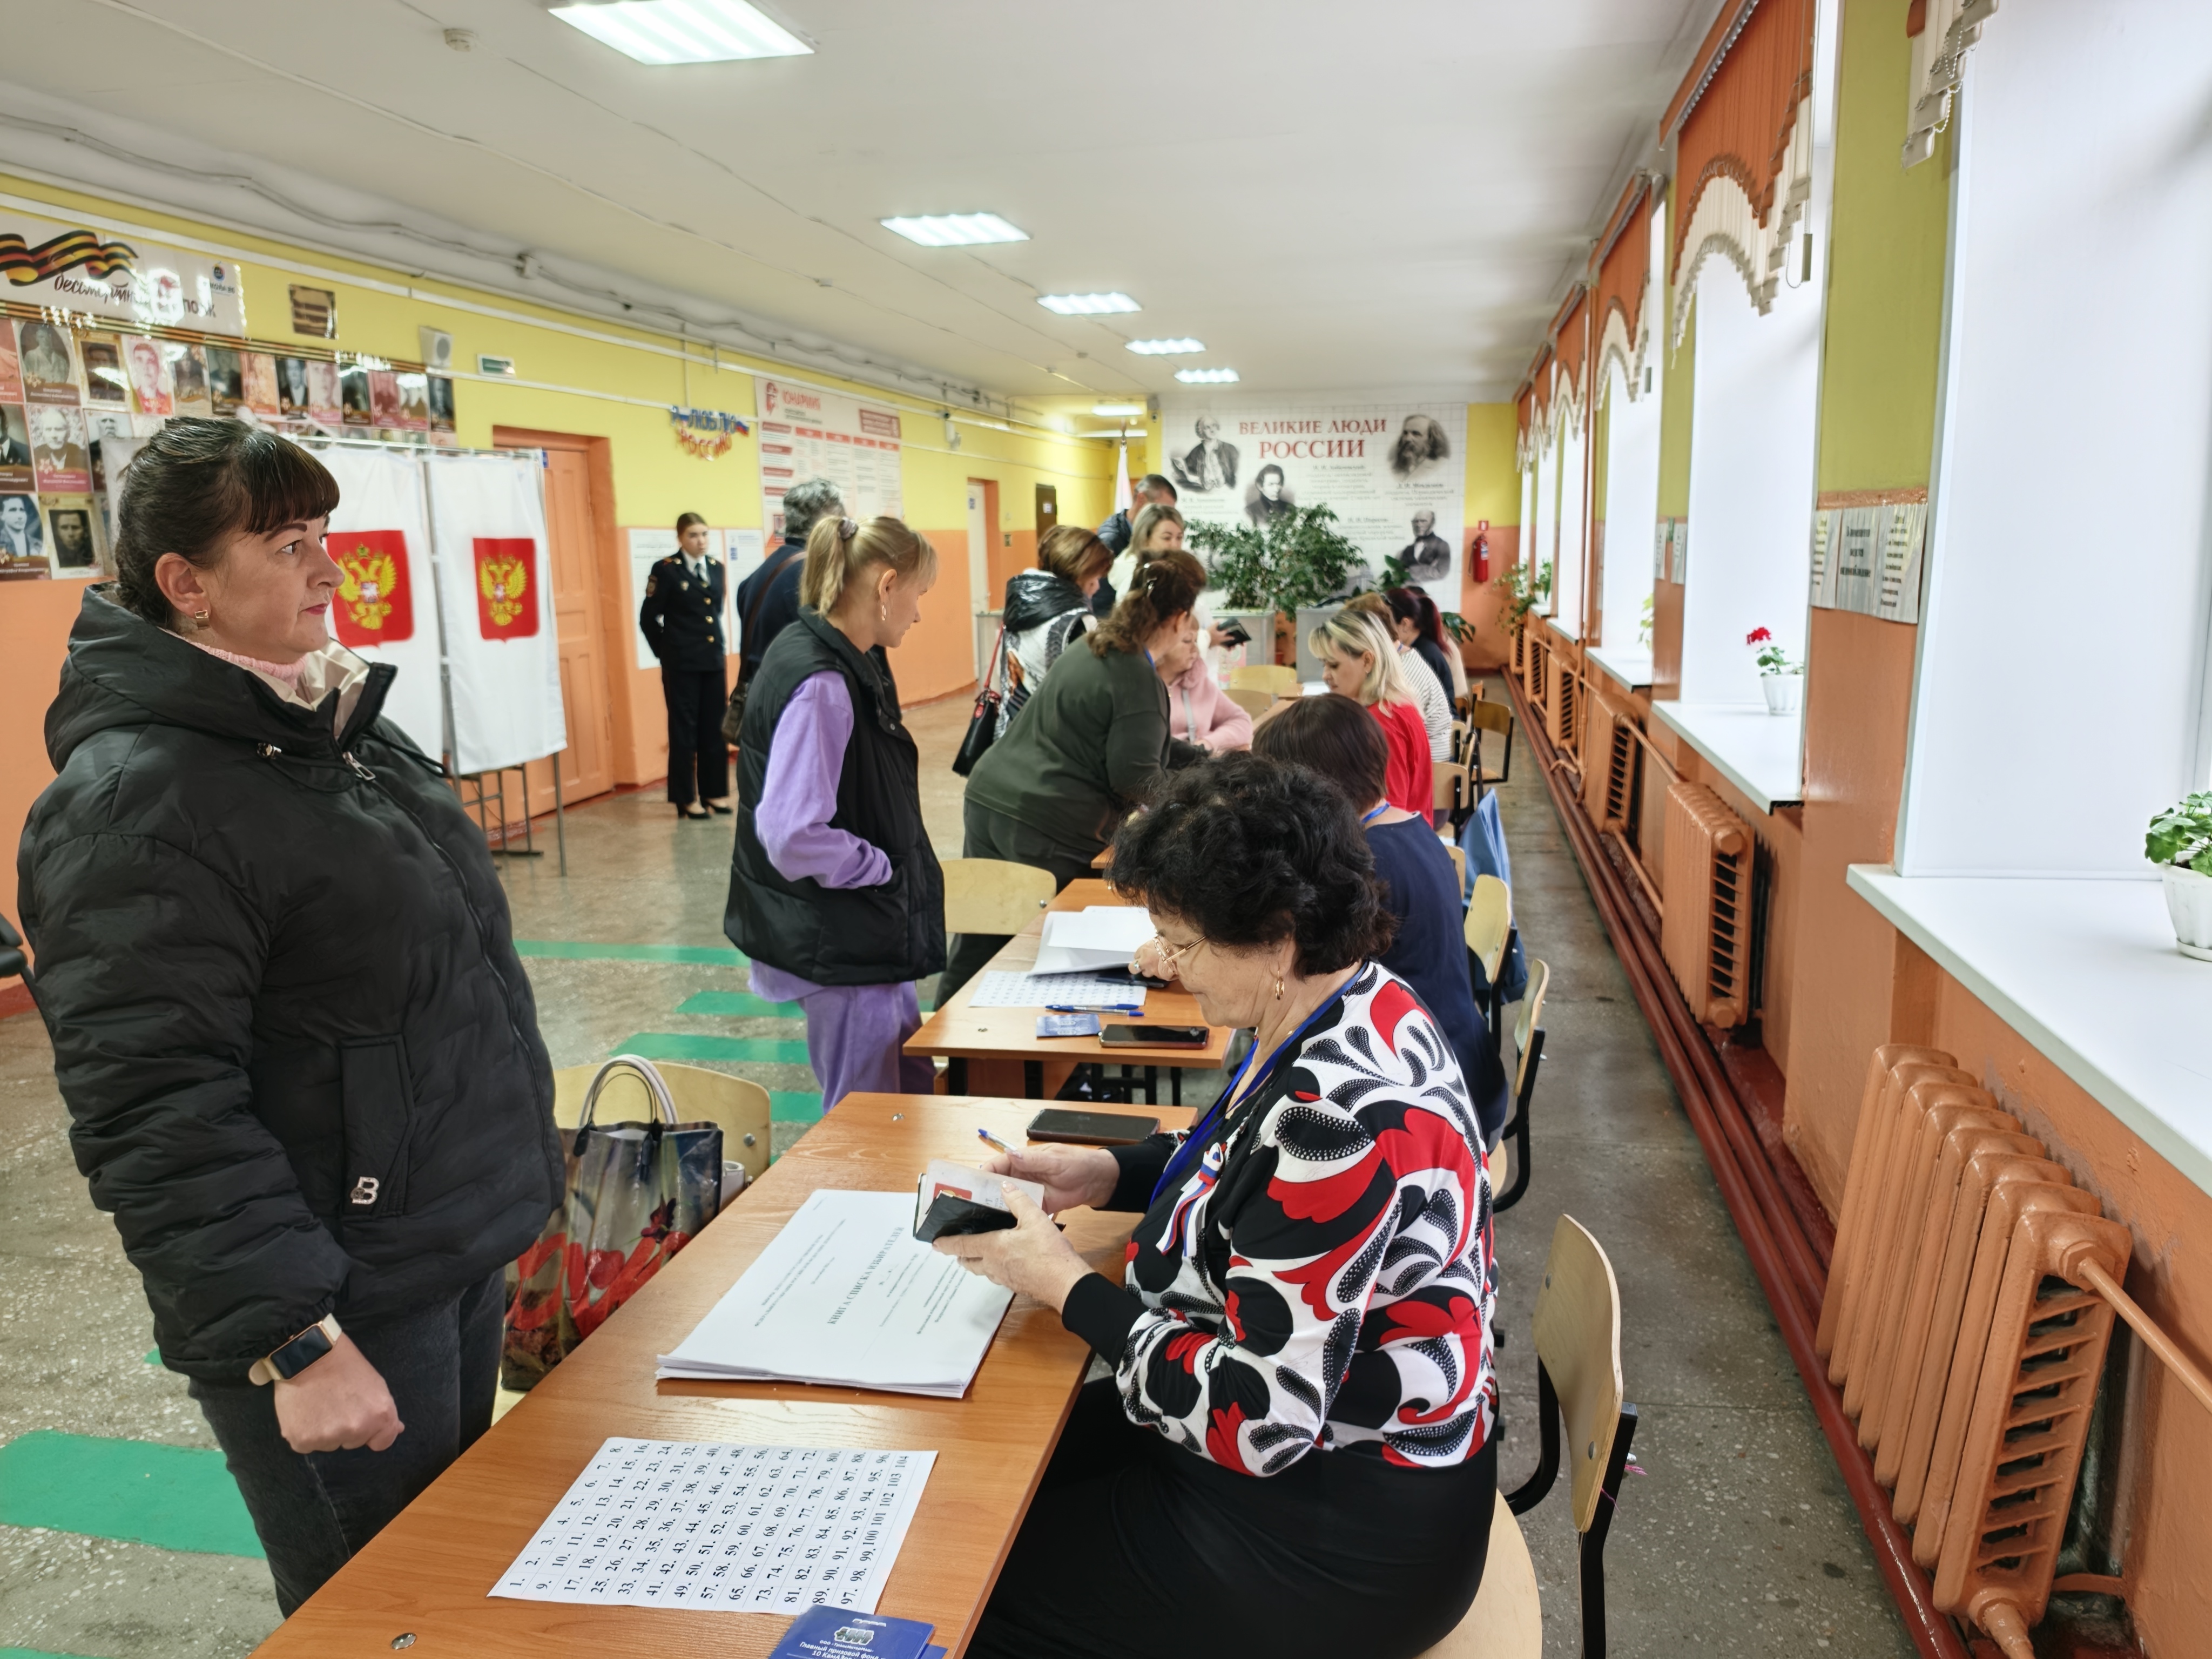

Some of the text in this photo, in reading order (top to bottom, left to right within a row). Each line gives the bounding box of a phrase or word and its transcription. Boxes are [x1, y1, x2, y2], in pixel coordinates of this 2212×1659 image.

[1239, 419, 1387, 435] ВЕЛИКИЕ ЛЮДИ
[1259, 440, 1365, 459] РОССИИ
[827, 1301, 852, 1324] КНИГА
[846, 1271, 873, 1299] СПИСКА
[867, 1227, 905, 1269] ИЗБИРАТЕЛЕЙ
[525, 1557, 541, 1566] 2.
[541, 1537, 556, 1546] 3.
[557, 1517, 570, 1525] 4.
[570, 1498, 584, 1506] 5.
[536, 1444, 650, 1589] 9. 10. 11. 12. 13. 14. 15. 16.
[564, 1445, 673, 1590] 17. 18. 19. 20. 21. 22. 23. 24.
[590, 1445, 697, 1593] 25. 26. 27. 28. 29. 30. 31. 32.
[617, 1446, 721, 1595] 33. 34. 35. 36. 37. 38. 39. 40.
[646, 1447, 745, 1596] 41. 42. 43. 44. 45. 46. 47. 48.
[673, 1448, 769, 1598] 49. 50. 51. 52. 53. 54. 55. 56.
[700, 1449, 793, 1599] 57. 58. 59. 60. 61. 62. 63. 64.
[729, 1450, 817, 1600] 65. 66. 67. 68. 69. 70. 71. 72.
[755, 1451, 841, 1601] 73. 74. 75. 76. 77. 78. 79. 80.
[784, 1452, 866, 1603] 81. 82. 83. 84. 85. 86. 87. 88.
[812, 1453, 891, 1604] 89. 90. 91. 92. 93. 94. 95. 96.
[840, 1456, 908, 1604] 97. 98. 99. 100 101 102 103 104
[799, 1642, 827, 1651] Главный
[828, 1648, 860, 1658] призовой
